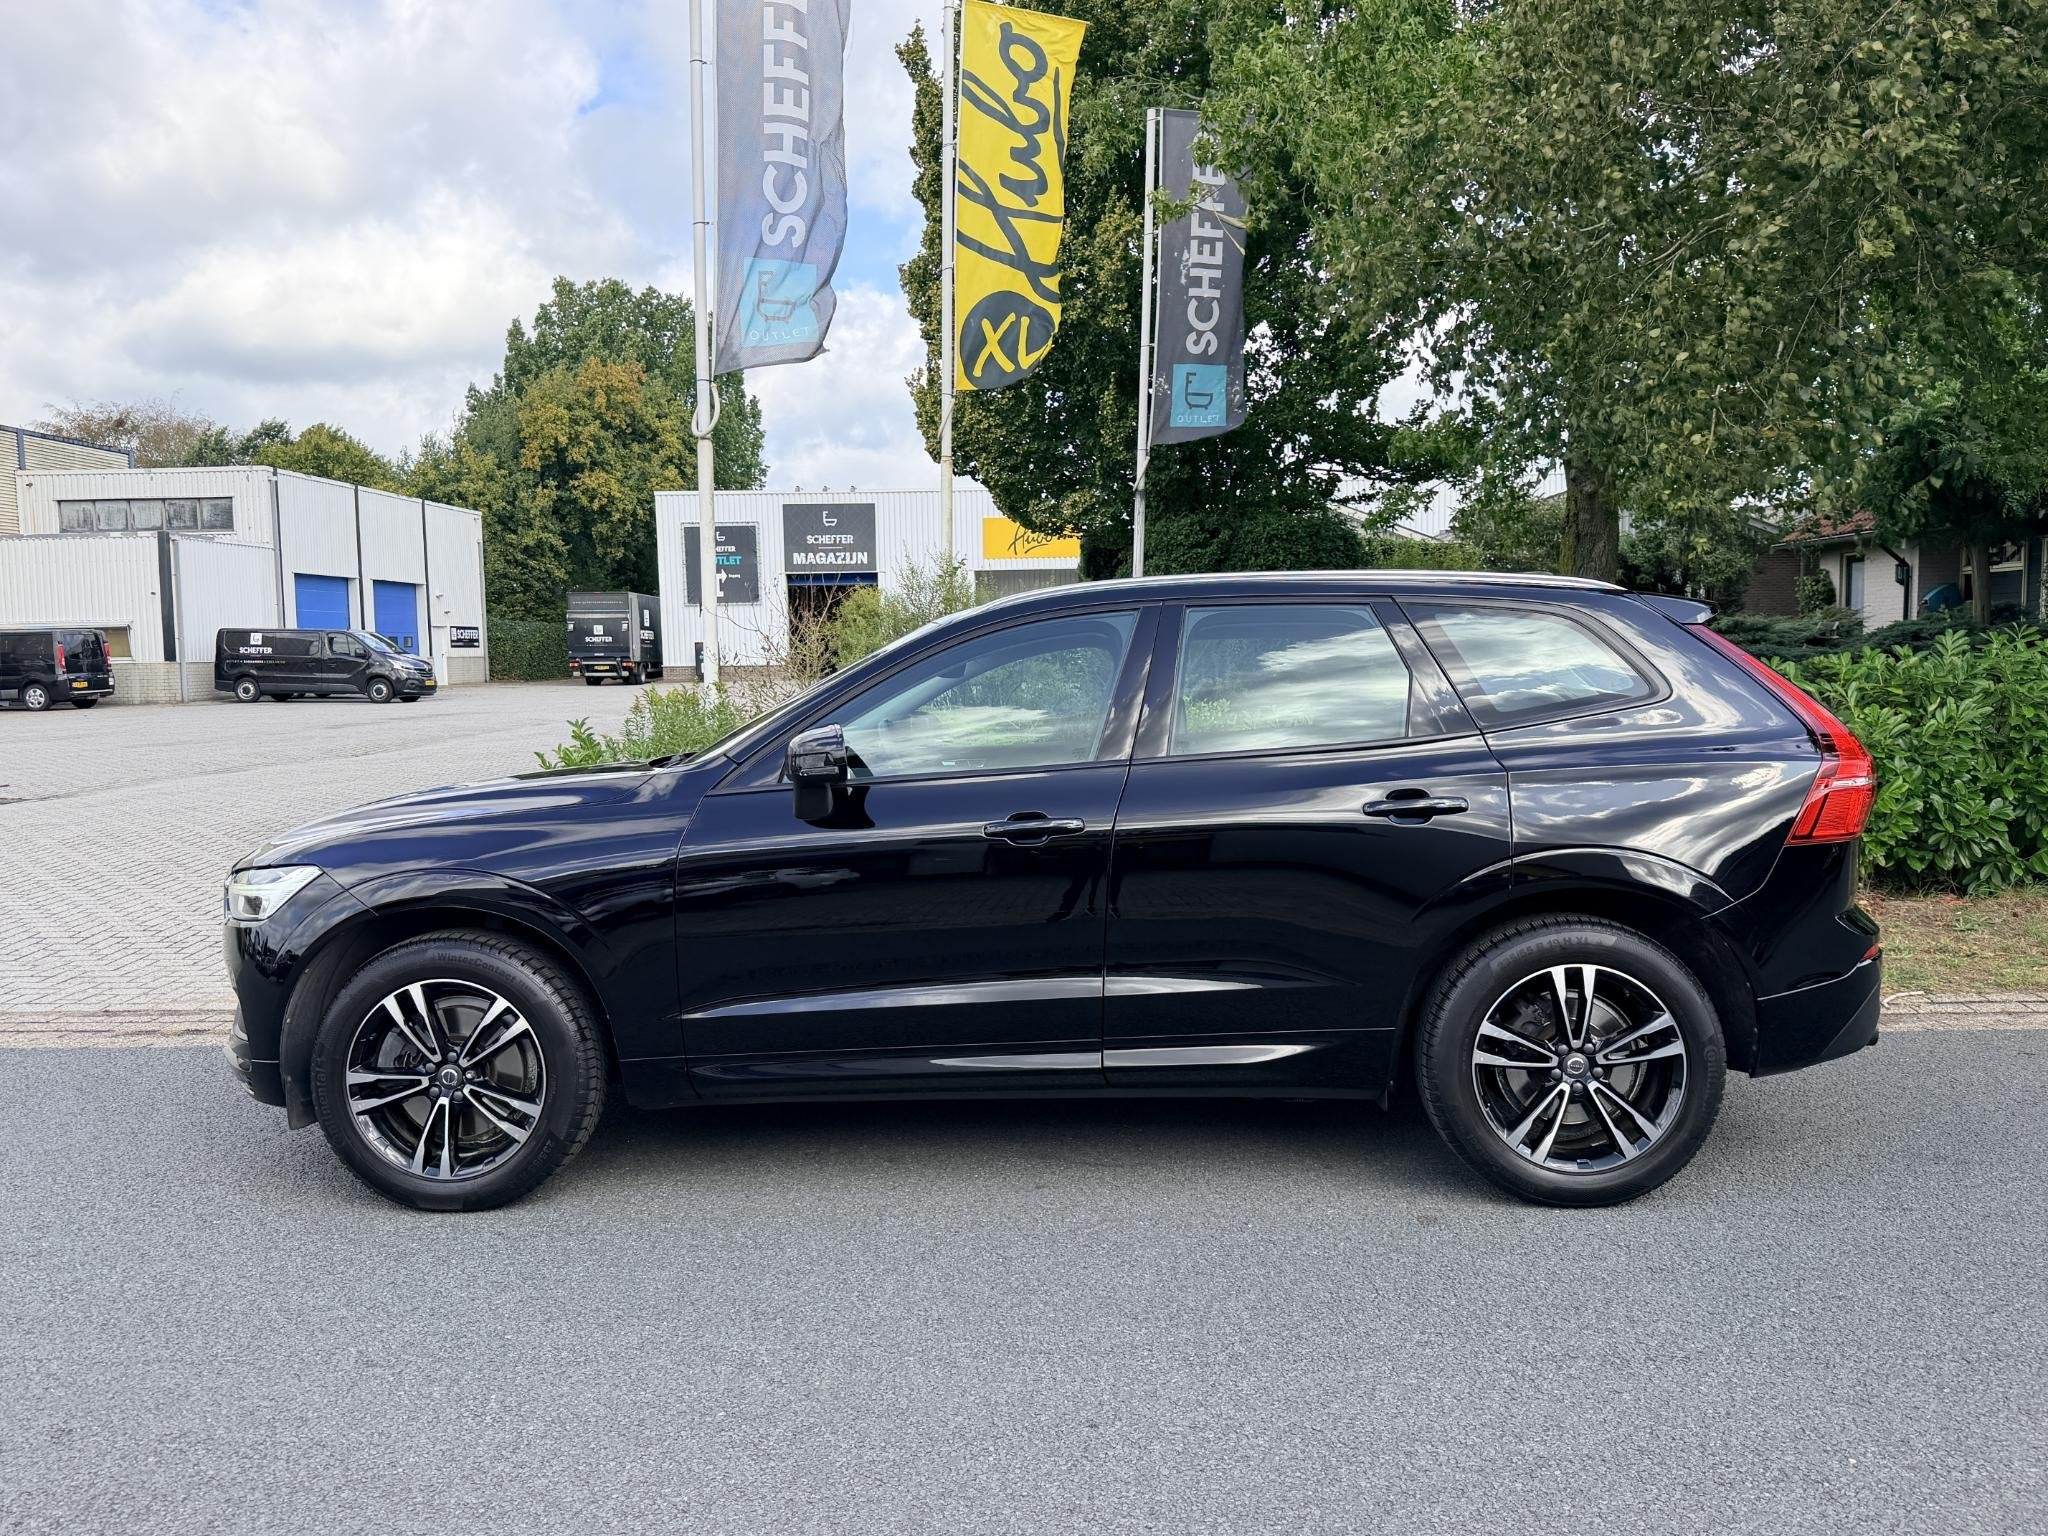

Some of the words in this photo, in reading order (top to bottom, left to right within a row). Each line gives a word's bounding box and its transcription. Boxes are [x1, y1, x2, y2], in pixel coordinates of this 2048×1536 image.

[761, 0, 809, 248] SCHEFF
[749, 325, 810, 342] OUTLET
[972, 312, 1054, 378] XL
[1176, 414, 1220, 424] OUTLET
[806, 534, 854, 545] SCHEFFER
[792, 551, 868, 565] MAGAZIJN
[239, 646, 273, 654] SCHEFFER
